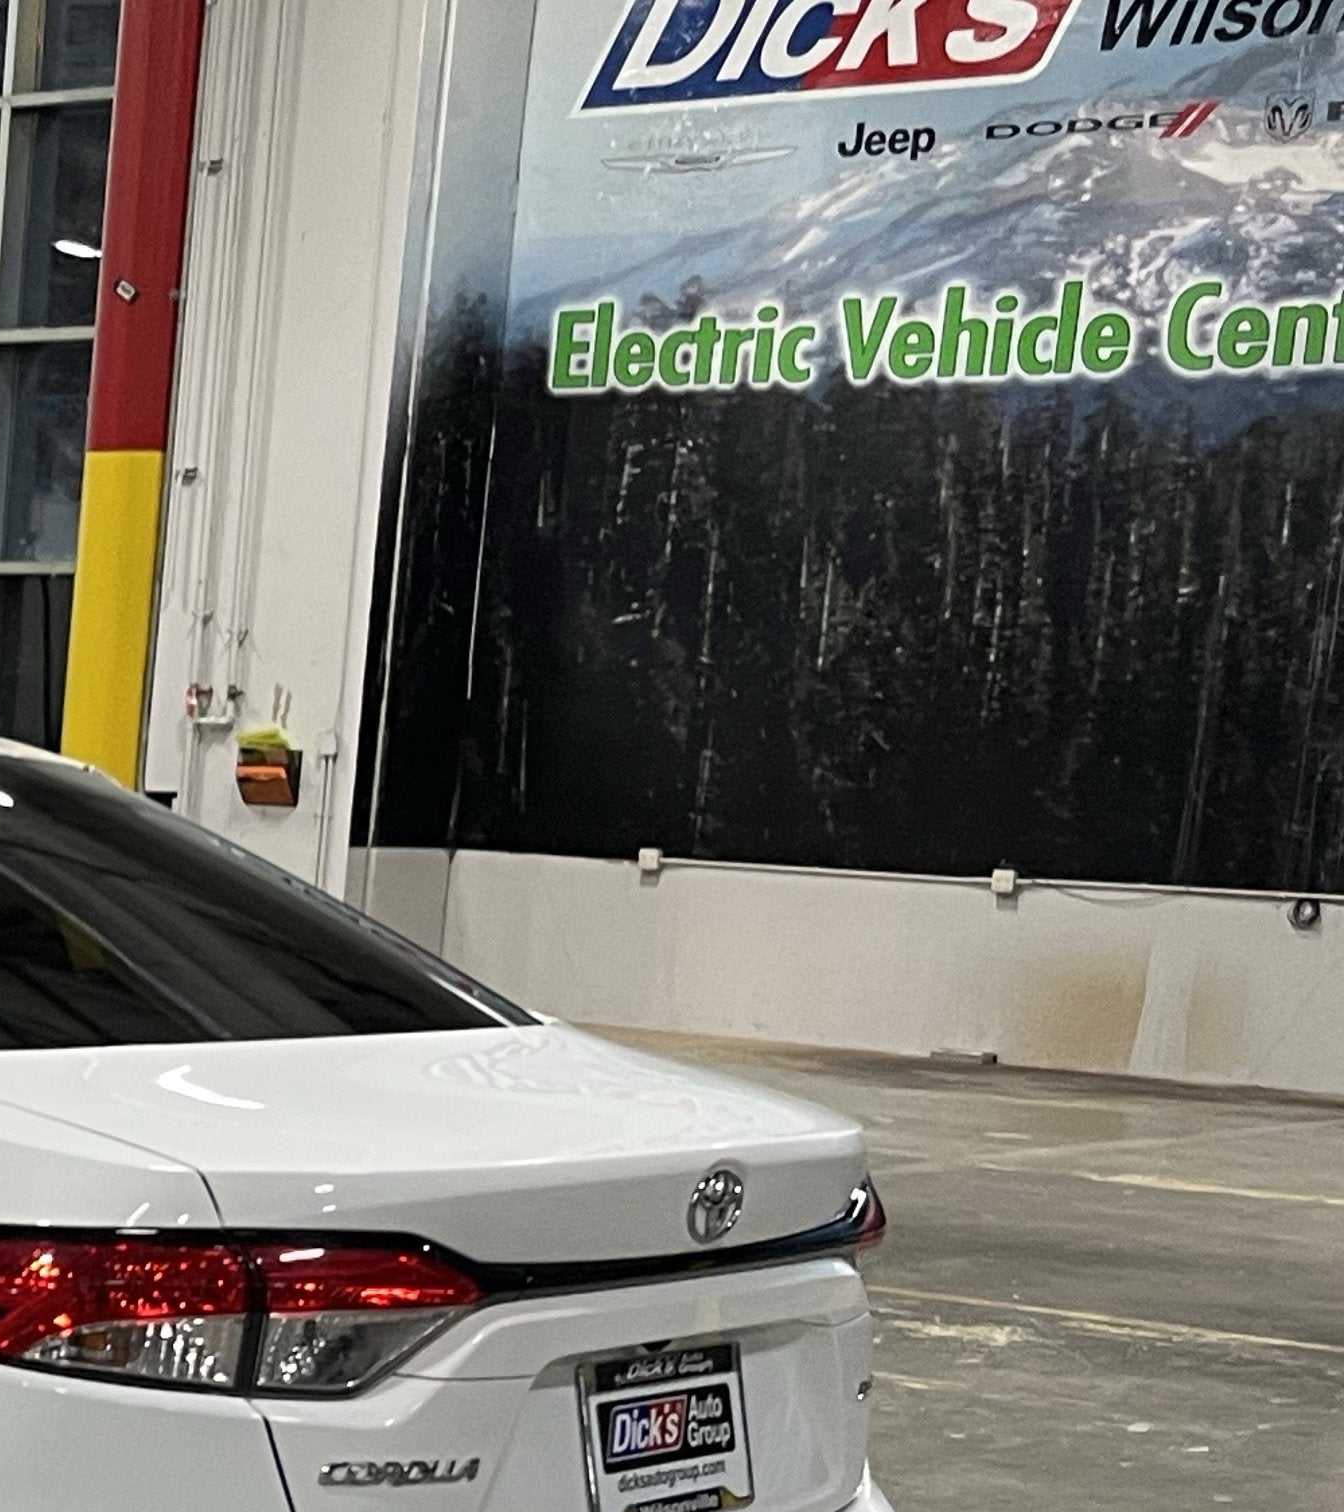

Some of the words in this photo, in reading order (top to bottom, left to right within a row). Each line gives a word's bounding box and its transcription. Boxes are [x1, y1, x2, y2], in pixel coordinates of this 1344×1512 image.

[612, 0, 1040, 90] Dicks
[837, 122, 936, 161] Jeep
[986, 110, 1184, 140] DODGE
[551, 301, 816, 391] Electric
[842, 280, 1132, 382] Vehicle
[687, 1393, 724, 1421] Auto
[613, 1403, 680, 1454] Dick's
[686, 1421, 732, 1449] Group
